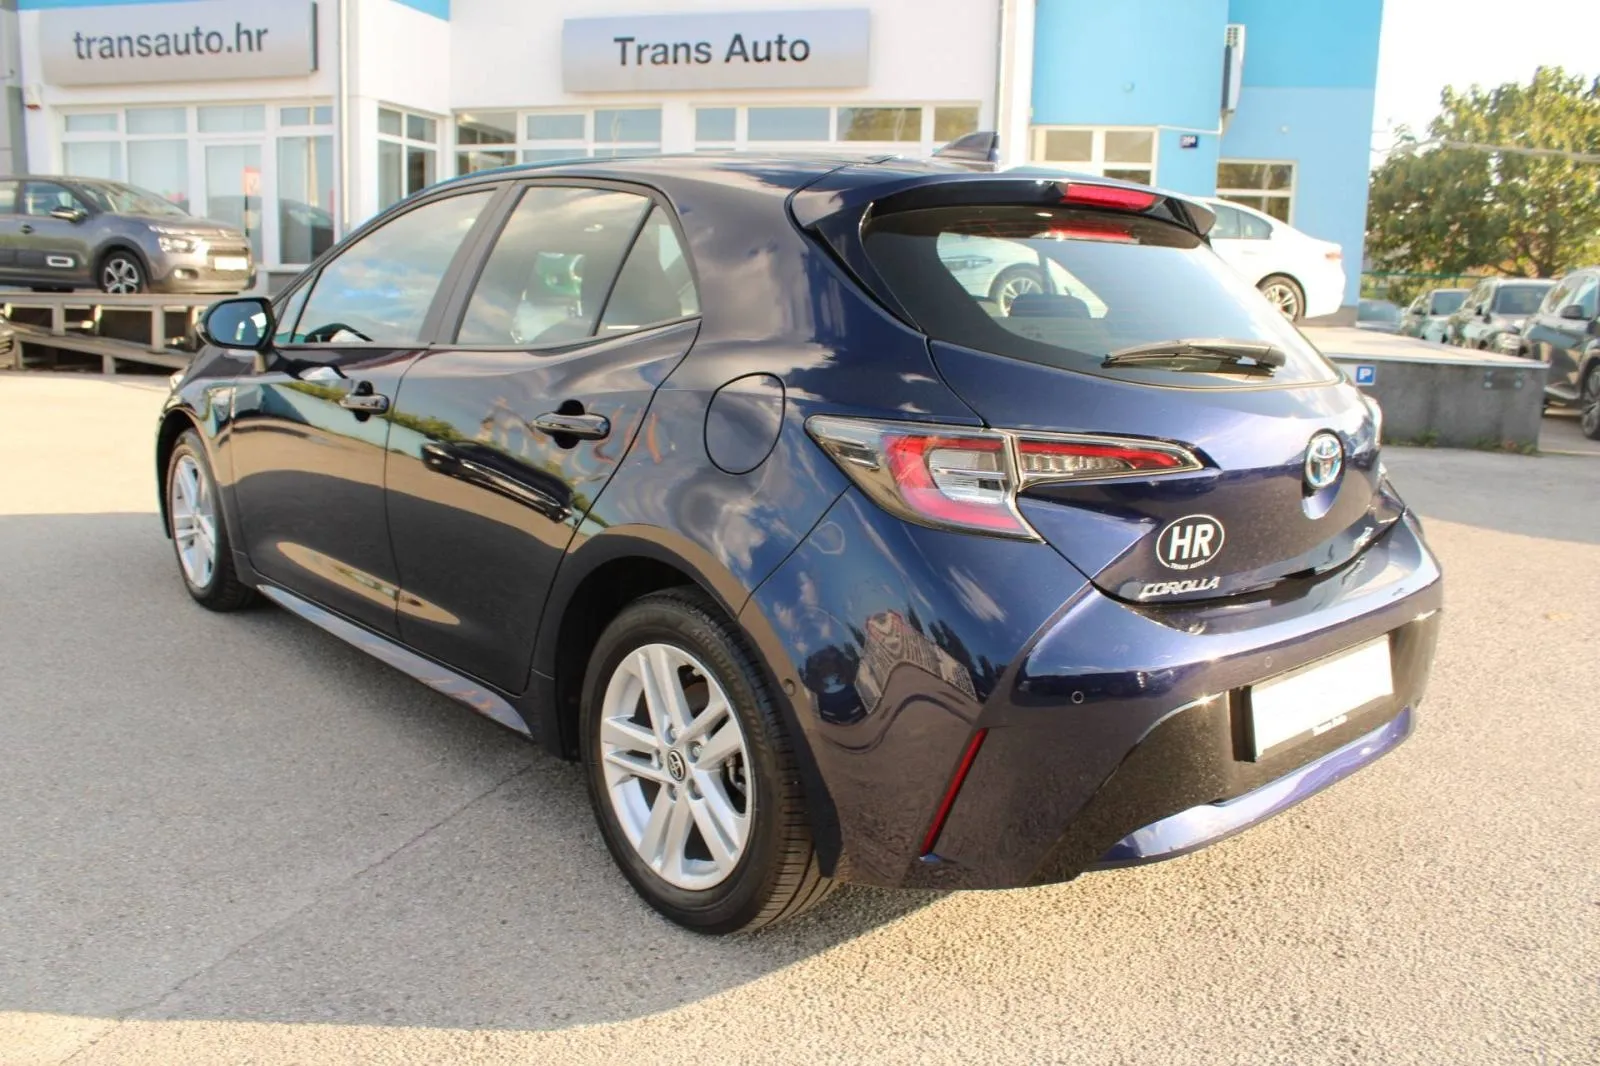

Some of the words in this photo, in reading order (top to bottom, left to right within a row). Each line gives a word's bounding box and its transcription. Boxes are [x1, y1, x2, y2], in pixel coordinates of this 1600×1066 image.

[73, 22, 269, 60] transauto.hr
[613, 36, 712, 66] Trans
[724, 33, 811, 63] Auto
[1359, 368, 1371, 380] P
[1168, 523, 1214, 561] HR
[1138, 576, 1221, 599] COROLLA
